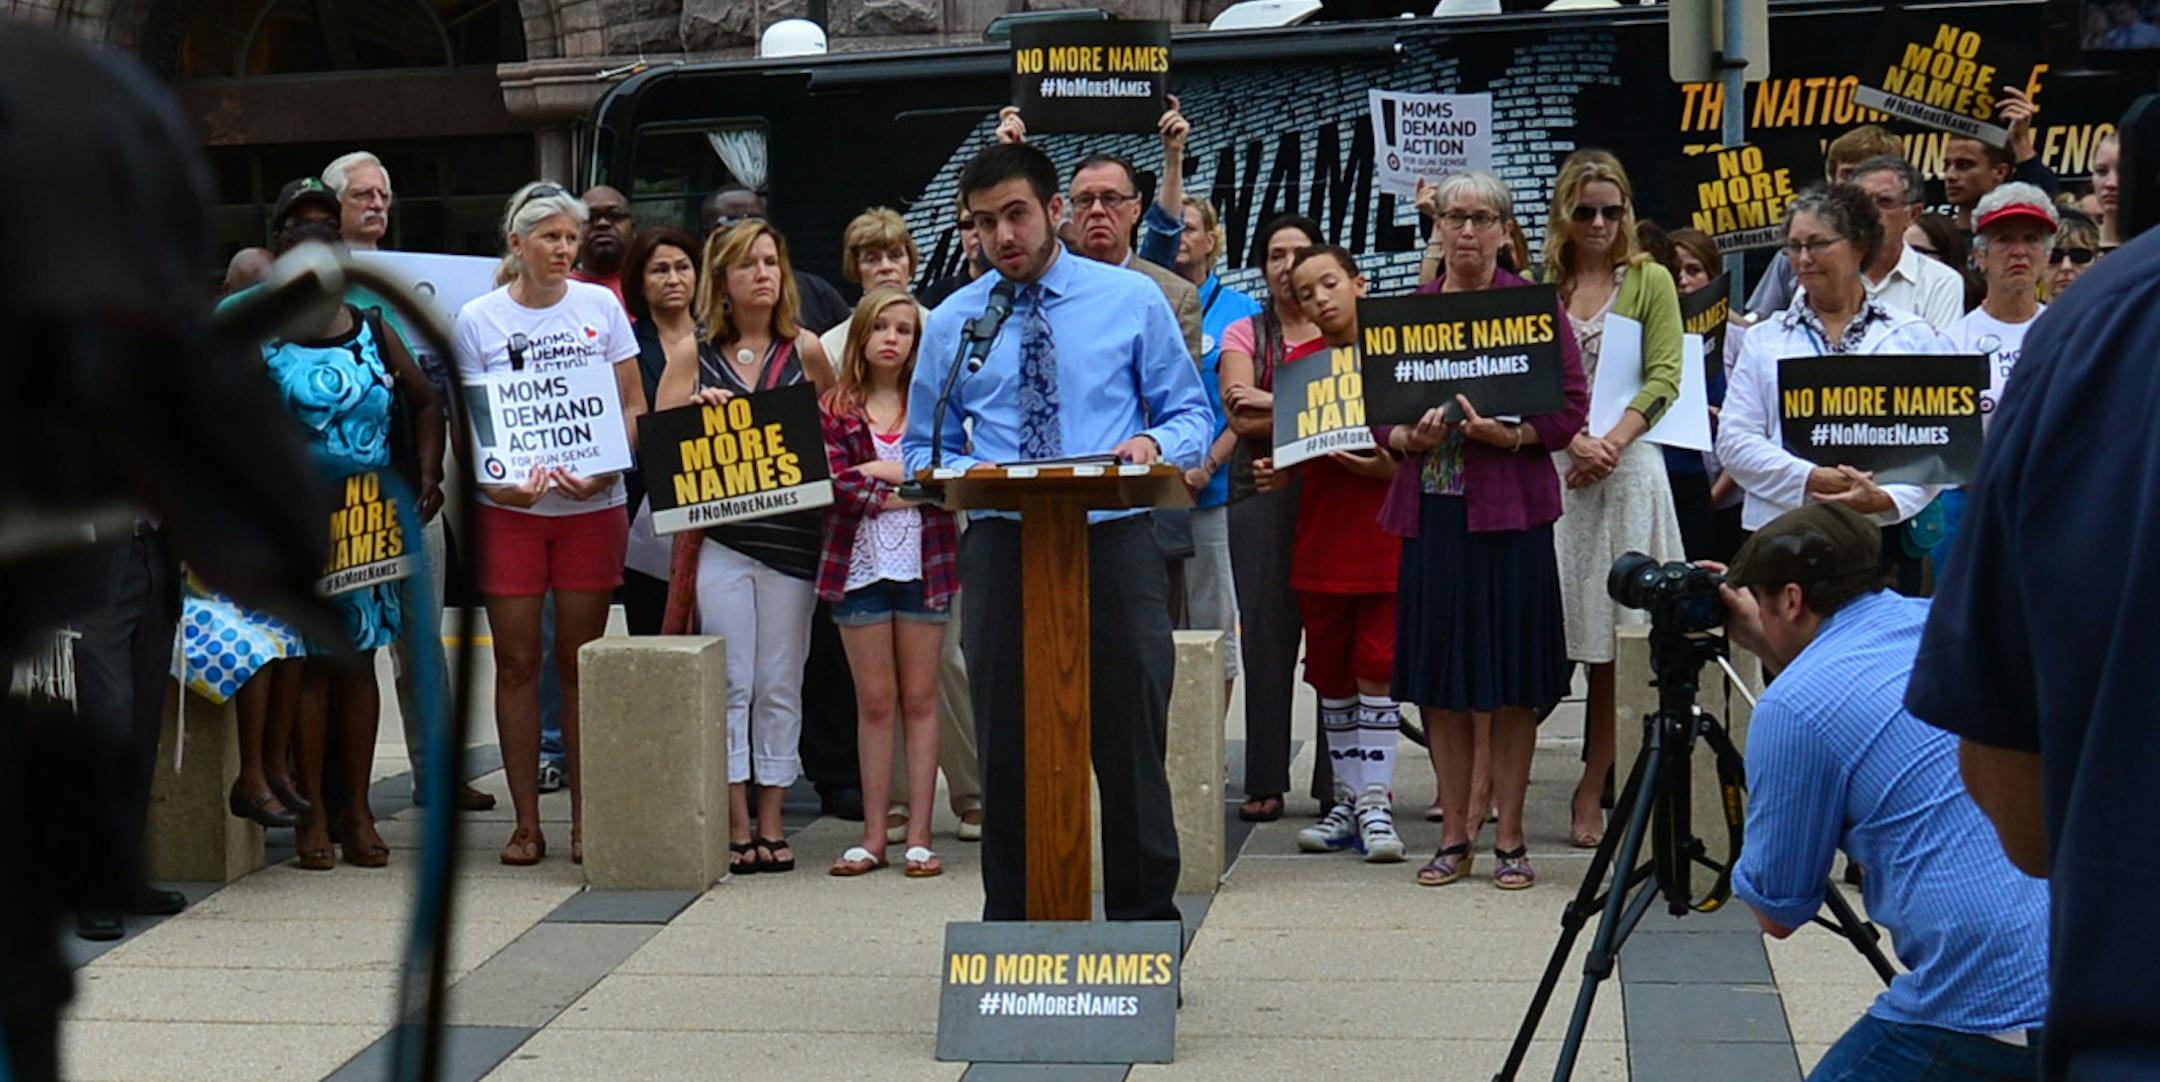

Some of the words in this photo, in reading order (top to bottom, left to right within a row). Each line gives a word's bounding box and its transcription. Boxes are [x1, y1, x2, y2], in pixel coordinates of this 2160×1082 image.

[1933, 23, 1981, 59] NO
[1016, 47, 1044, 74] NO
[1049, 46, 1103, 72] MORE
[1108, 46, 1169, 73] NAMES
[1901, 43, 1996, 93] MORE
[1040, 77, 1151, 97] #NoMoreNames
[1882, 65, 1995, 120] NAMES
[1402, 101, 1453, 118] MOMS
[1680, 82, 1725, 131] TH
[1402, 120, 1476, 136] DEMAND
[1403, 138, 1463, 155] ACTION
[1903, 132, 1951, 180] UN
[1717, 147, 1763, 179] NO
[1698, 168, 1792, 209] MORE
[1692, 194, 1798, 236] NAME
[1365, 326, 1396, 355] NO
[1403, 322, 1466, 353] MORE
[1471, 314, 1553, 349] NAMES
[1332, 345, 1360, 376] N
[1394, 355, 1530, 383] #NoMoreNames
[498, 376, 568, 404] MOMS
[1307, 372, 1361, 409] MO
[1785, 387, 1813, 418] NO
[1822, 386, 1887, 416] MORE
[1894, 386, 1975, 416] NAMES
[503, 396, 604, 428] DEMAND
[702, 397, 753, 436] NO
[509, 423, 592, 452] ACTION
[680, 423, 786, 472] MORE
[1811, 423, 1949, 447] #NoMoreNames
[511, 456, 532, 467] FOR
[561, 446, 601, 462] SENSE
[345, 472, 379, 507] NO
[673, 452, 802, 506] NAMES
[330, 498, 397, 540] MORE
[688, 492, 799, 523] #NoMoreNames
[950, 954, 987, 985] NO
[994, 954, 1070, 985] MORE
[1076, 953, 1173, 986] NAMES
[979, 992, 1138, 1016] #NoMoreNames
